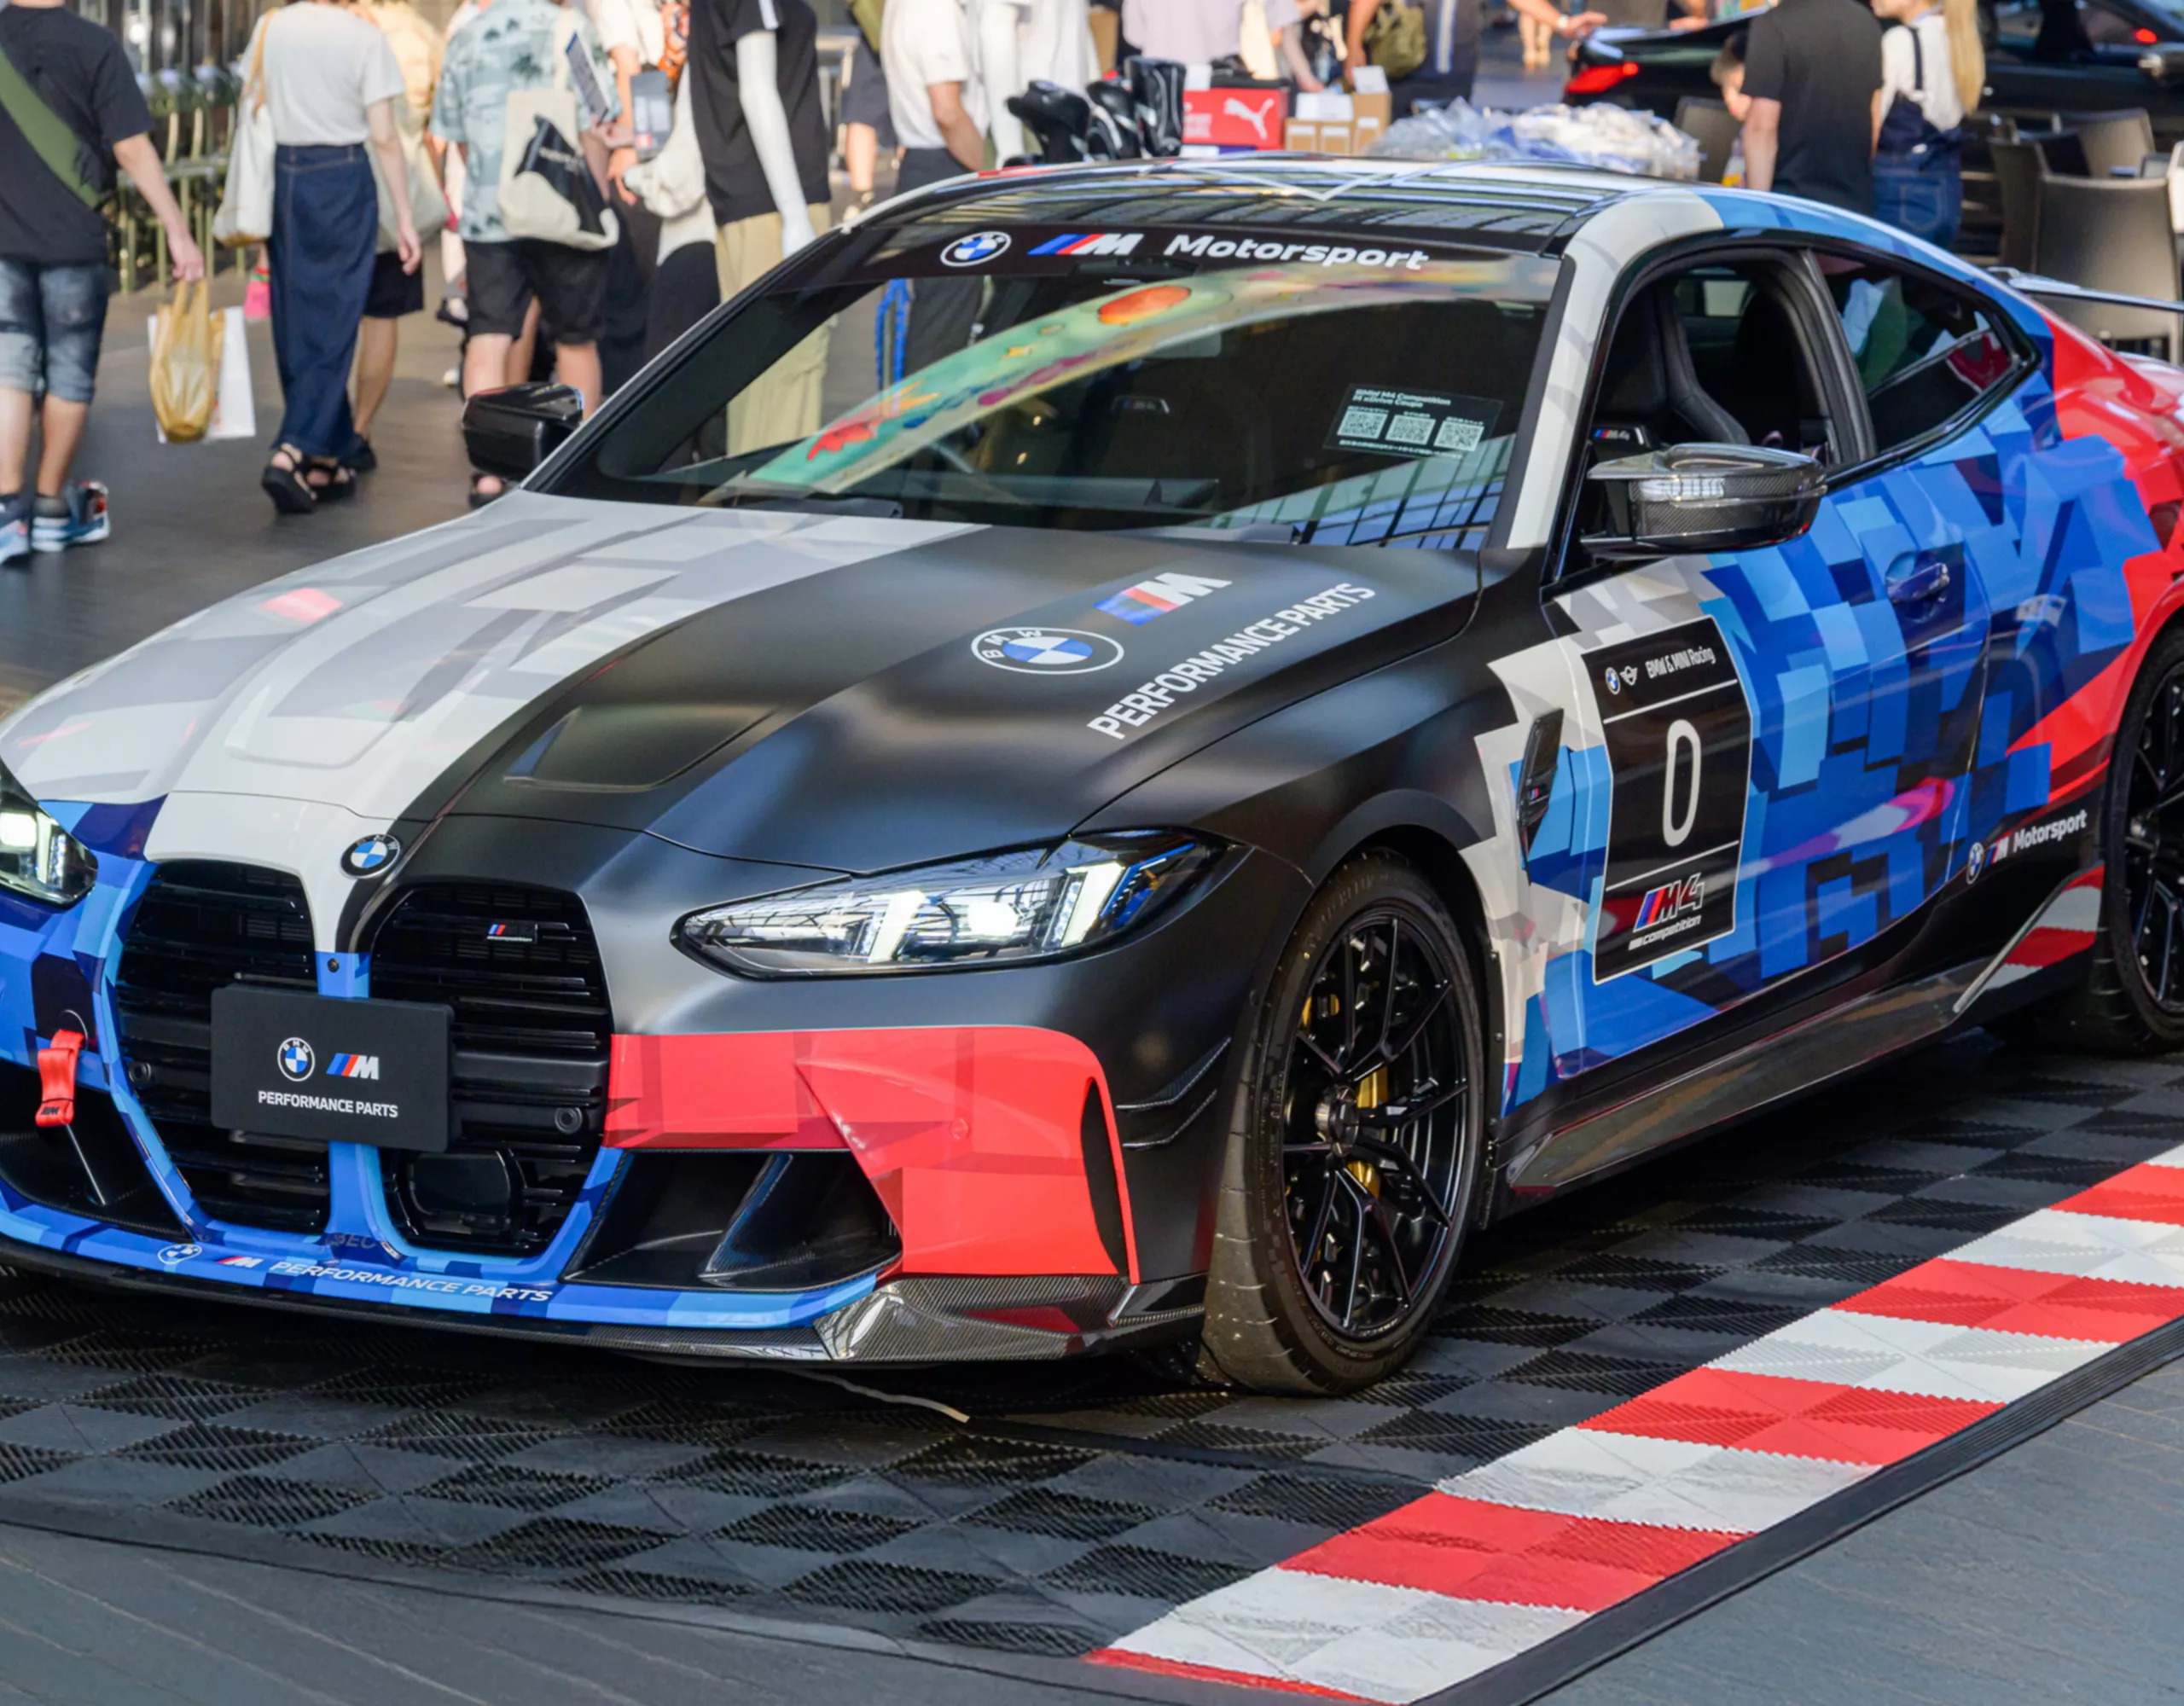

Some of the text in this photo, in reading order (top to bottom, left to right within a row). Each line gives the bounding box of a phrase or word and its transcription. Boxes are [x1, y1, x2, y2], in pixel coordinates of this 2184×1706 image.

[1070, 233, 1429, 270] M Motorsport
[1133, 572, 1233, 607] M
[1086, 582, 1376, 740] PERFORMANCE PARTS
[1645, 656, 1667, 679] BMW
[1670, 650, 1692, 671] MINI
[1687, 645, 1716, 666] Racing
[1662, 718, 1702, 848] 0
[2013, 809, 2088, 853] Motorsport
[1655, 872, 1705, 923] M4
[1641, 914, 1702, 941] competition
[348, 1054, 380, 1081] M
[258, 1089, 399, 1118] PERFORMANCE PARTS
[269, 1261, 461, 1293] PERFORMANCE
[461, 1284, 554, 1303] PARTS
